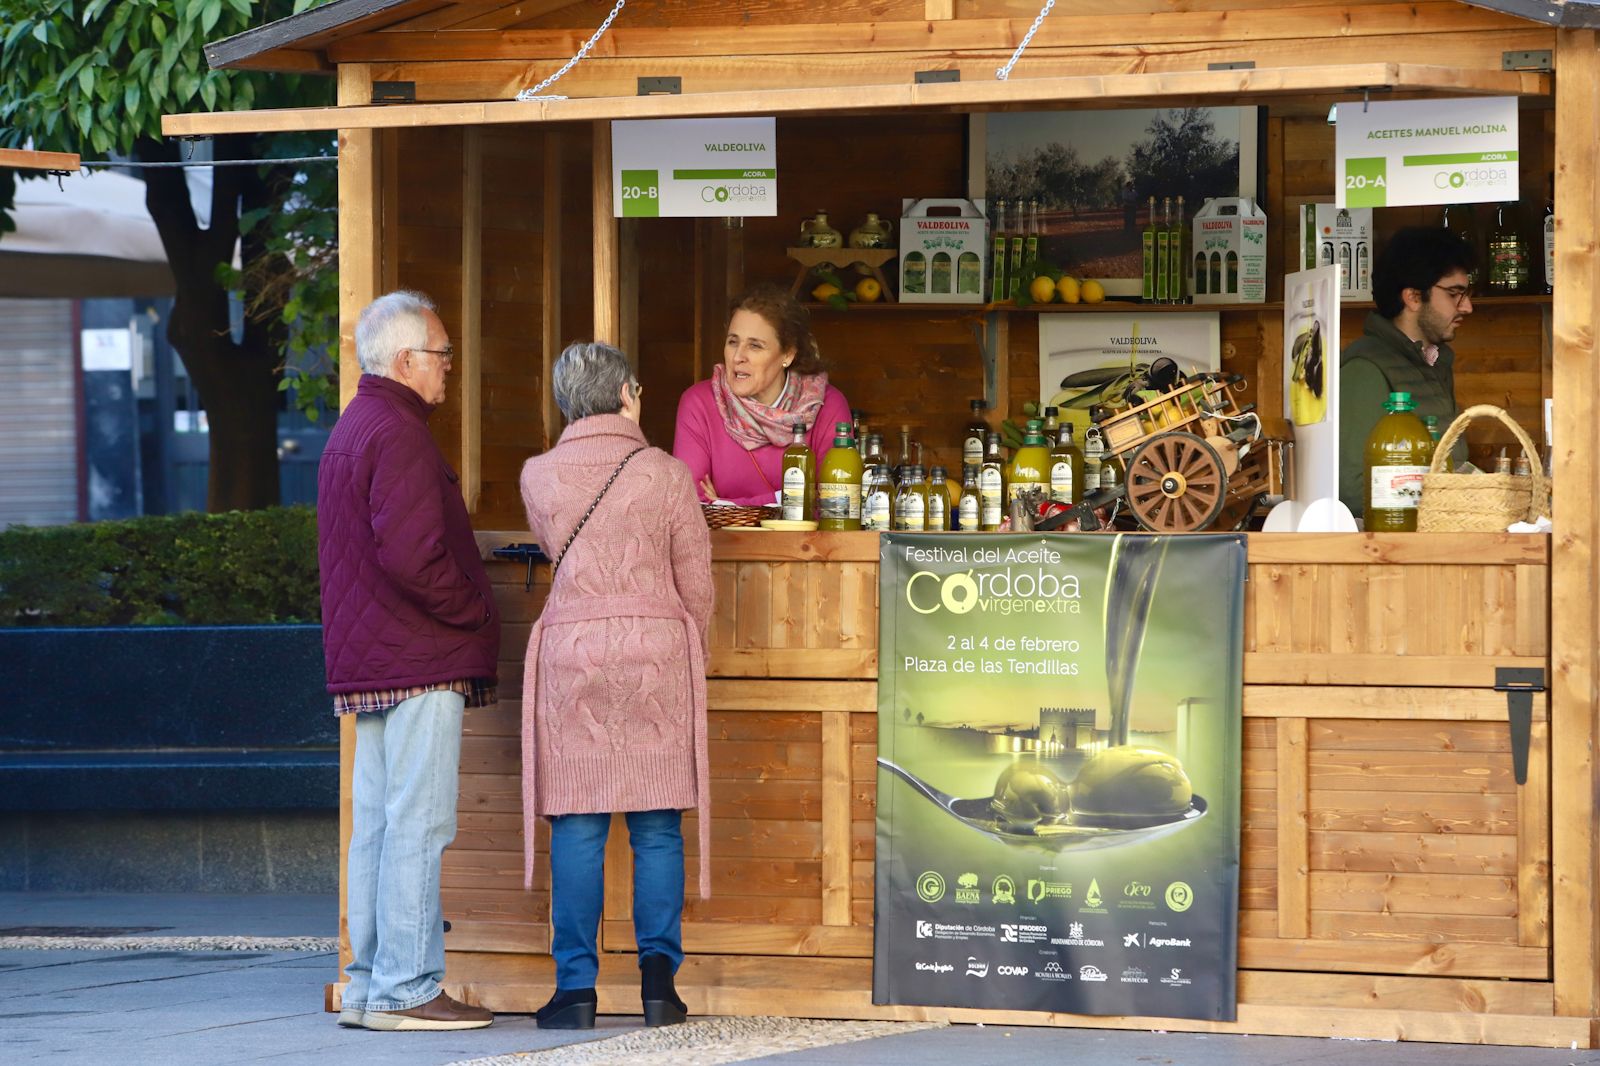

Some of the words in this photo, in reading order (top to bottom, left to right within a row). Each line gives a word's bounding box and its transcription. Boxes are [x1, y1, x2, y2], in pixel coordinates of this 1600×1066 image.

[1367, 128, 1413, 139] ACEITES
[1415, 126, 1461, 137] MANUEL
[1463, 124, 1507, 135] MOLINA
[704, 143, 766, 152] VALDEOLIVA
[1480, 153, 1507, 161] ACORA
[742, 170, 766, 178] ACORA
[1434, 168, 1507, 190] Córdoba
[1346, 175, 1386, 189] 20-A
[623, 186, 657, 199] 20-B
[701, 184, 766, 203] Córdoba
[917, 221, 970, 230] VALDEOLIVA
[1202, 220, 1233, 230] VALDEOLIVA
[1110, 337, 1157, 345] VALDEOLIVA
[906, 546, 968, 563] Festival
[973, 547, 1000, 563] del
[1005, 548, 1061, 564] Aceite
[906, 567, 1081, 614] Córdoba
[978, 597, 1081, 615] virgenextra
[947, 635, 956, 650] 2
[961, 635, 975, 650] al
[979, 636, 989, 651] 4
[994, 636, 1016, 651] de
[1021, 636, 1080, 652] febrero
[905, 656, 947, 673] Plaza
[952, 657, 976, 673] de
[981, 658, 1003, 674] las
[1007, 658, 1079, 676] Tendillas
[956, 891, 980, 900] BAENA
[1046, 887, 1072, 895] PRIEGO
[935, 924, 964, 932] Diputación
[973, 925, 996, 933] Córdoba
[1019, 925, 1048, 933] IPRODECO
[1149, 937, 1192, 948] AgroBank
[997, 966, 1029, 976] COVAP
